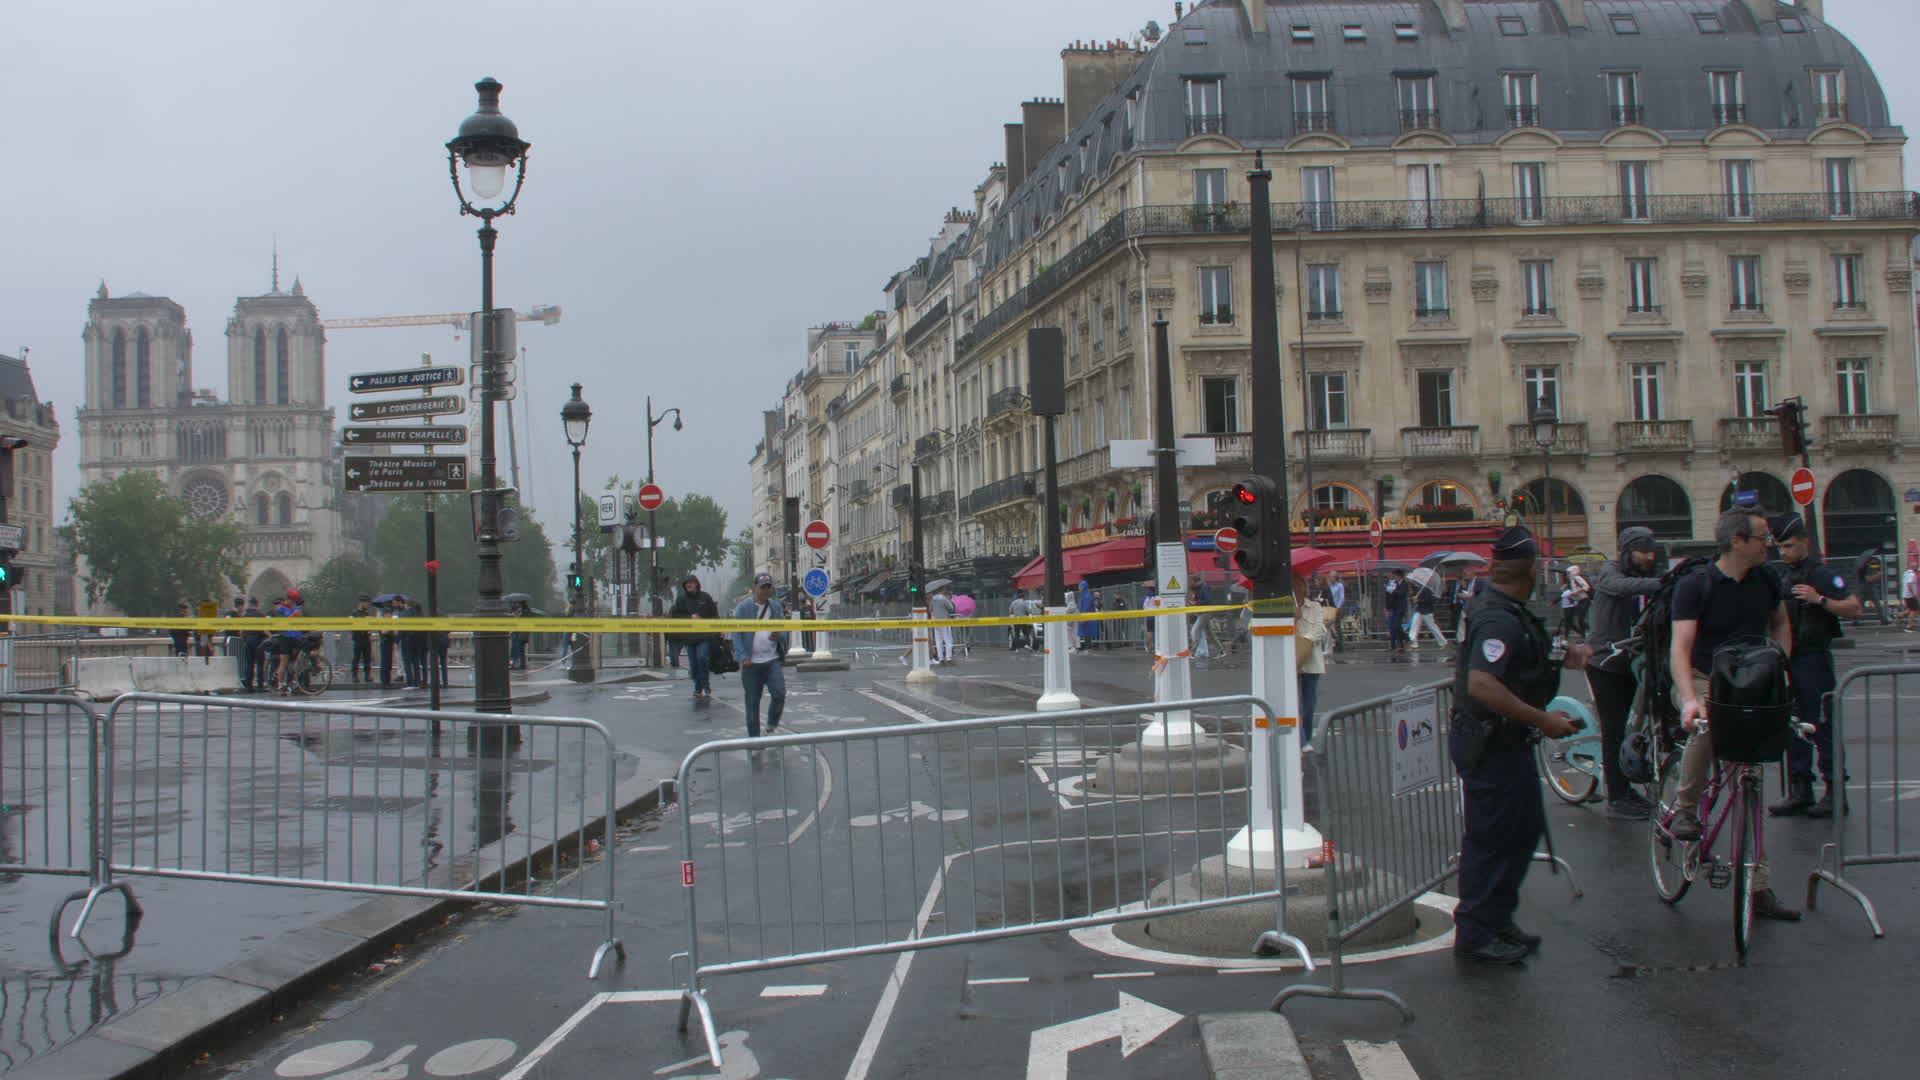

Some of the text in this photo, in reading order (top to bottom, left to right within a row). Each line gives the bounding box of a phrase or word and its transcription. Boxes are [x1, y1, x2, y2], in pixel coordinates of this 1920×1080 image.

[369, 372, 442, 385] PALAIS DE JUSTICE
[376, 400, 446, 414] LA CONCIERGERIE
[375, 431, 451, 439] SAINTE CHAPELLE
[402, 459, 436, 468] Musical
[381, 468, 403, 476] Paris
[403, 479, 413, 487] de
[416, 479, 424, 487] la
[428, 479, 447, 487] Ville
[602, 503, 614, 512] RER
[995, 536, 1025, 545] GIBERT
